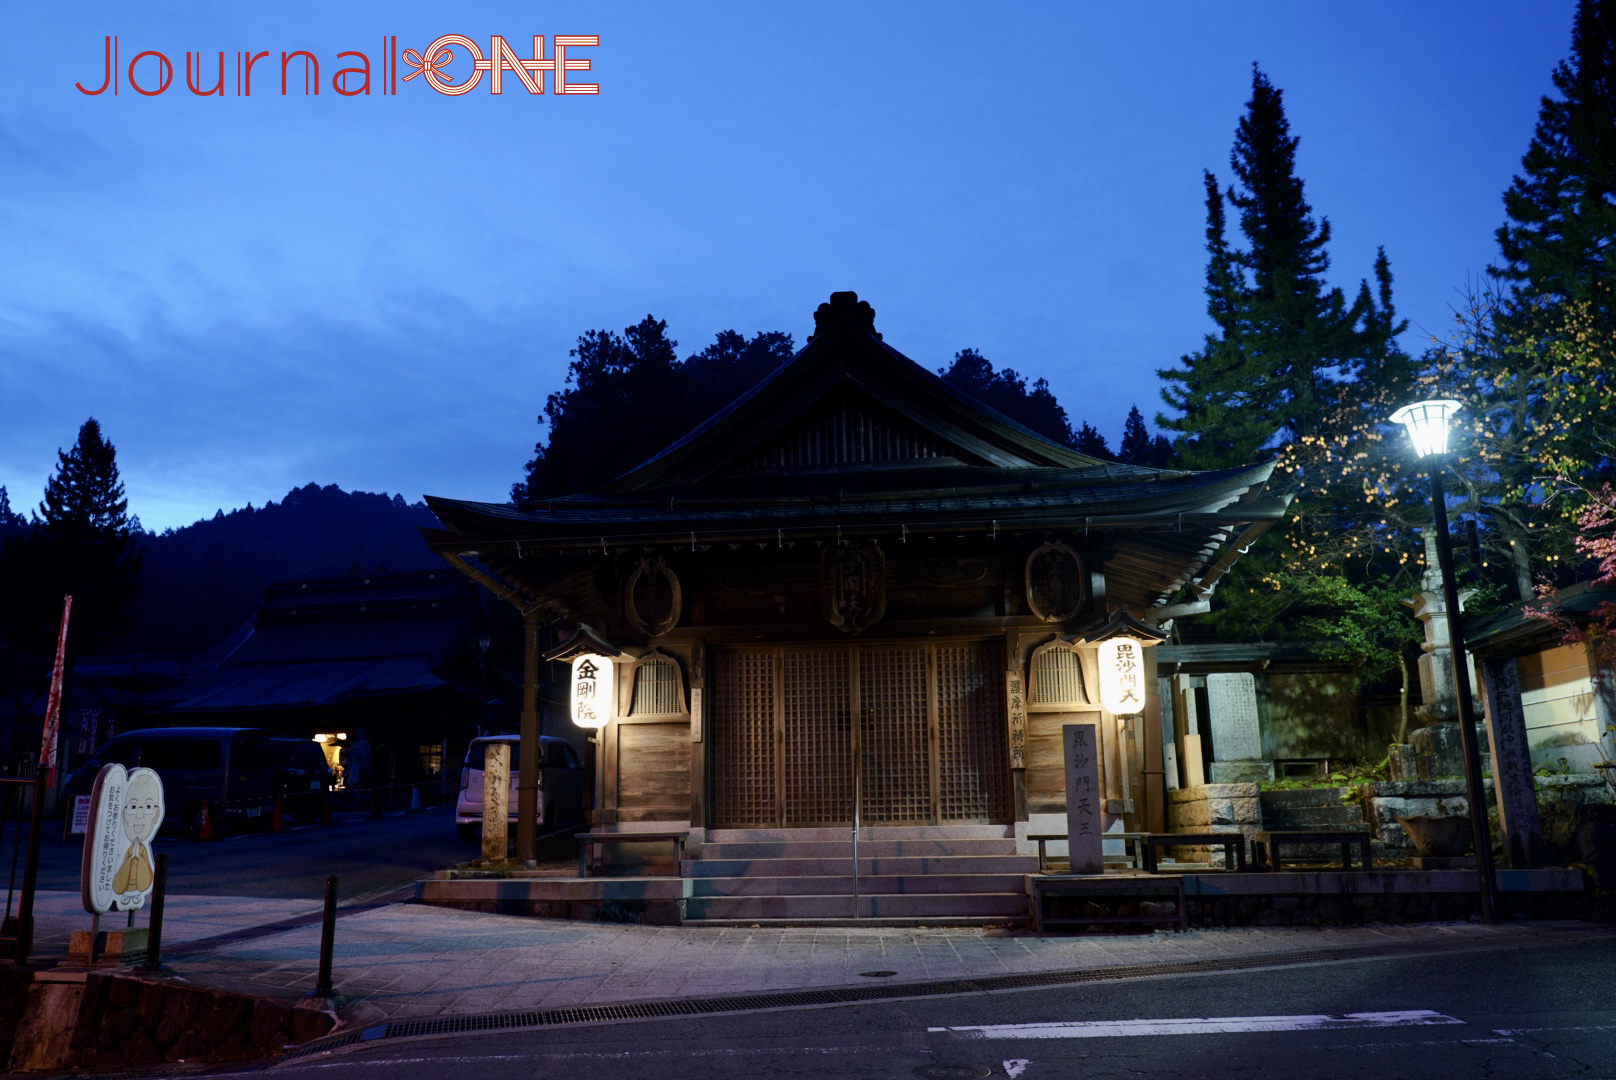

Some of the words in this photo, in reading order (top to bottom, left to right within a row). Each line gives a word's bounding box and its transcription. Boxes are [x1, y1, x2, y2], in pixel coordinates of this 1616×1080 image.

[576, 658, 600, 720] 金剛院
[1115, 644, 1140, 703] 毘沙門天
[1073, 730, 1093, 836] 毘沙門天王
[98, 786, 115, 891] お気をつけてお帰りください
[104, 786, 121, 891] よくお参りくださいました
